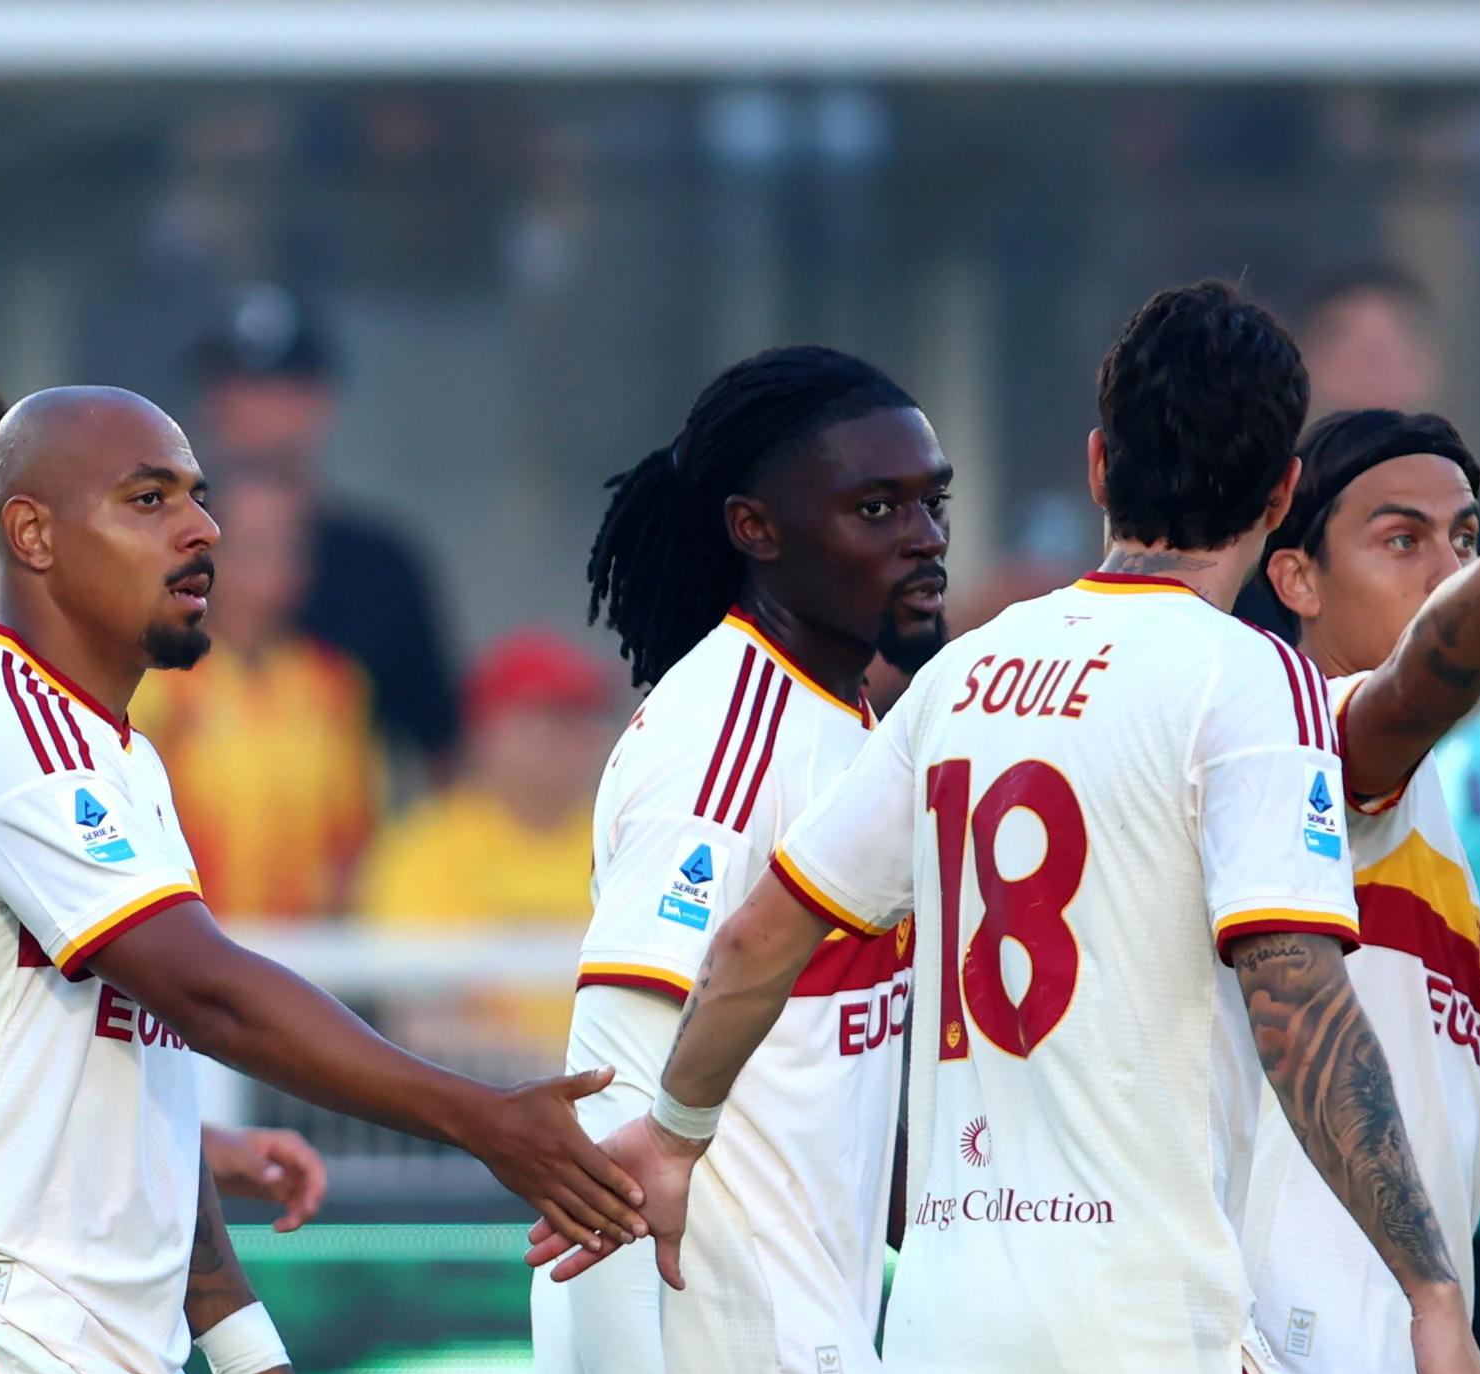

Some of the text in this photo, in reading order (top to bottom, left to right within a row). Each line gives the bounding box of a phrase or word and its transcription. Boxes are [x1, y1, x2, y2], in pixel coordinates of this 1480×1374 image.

[951, 643, 1115, 719] SOULÉ
[671, 880, 701, 897] SERIE
[925, 758, 1091, 1061] 18
[962, 1188, 1116, 1224] Collection
